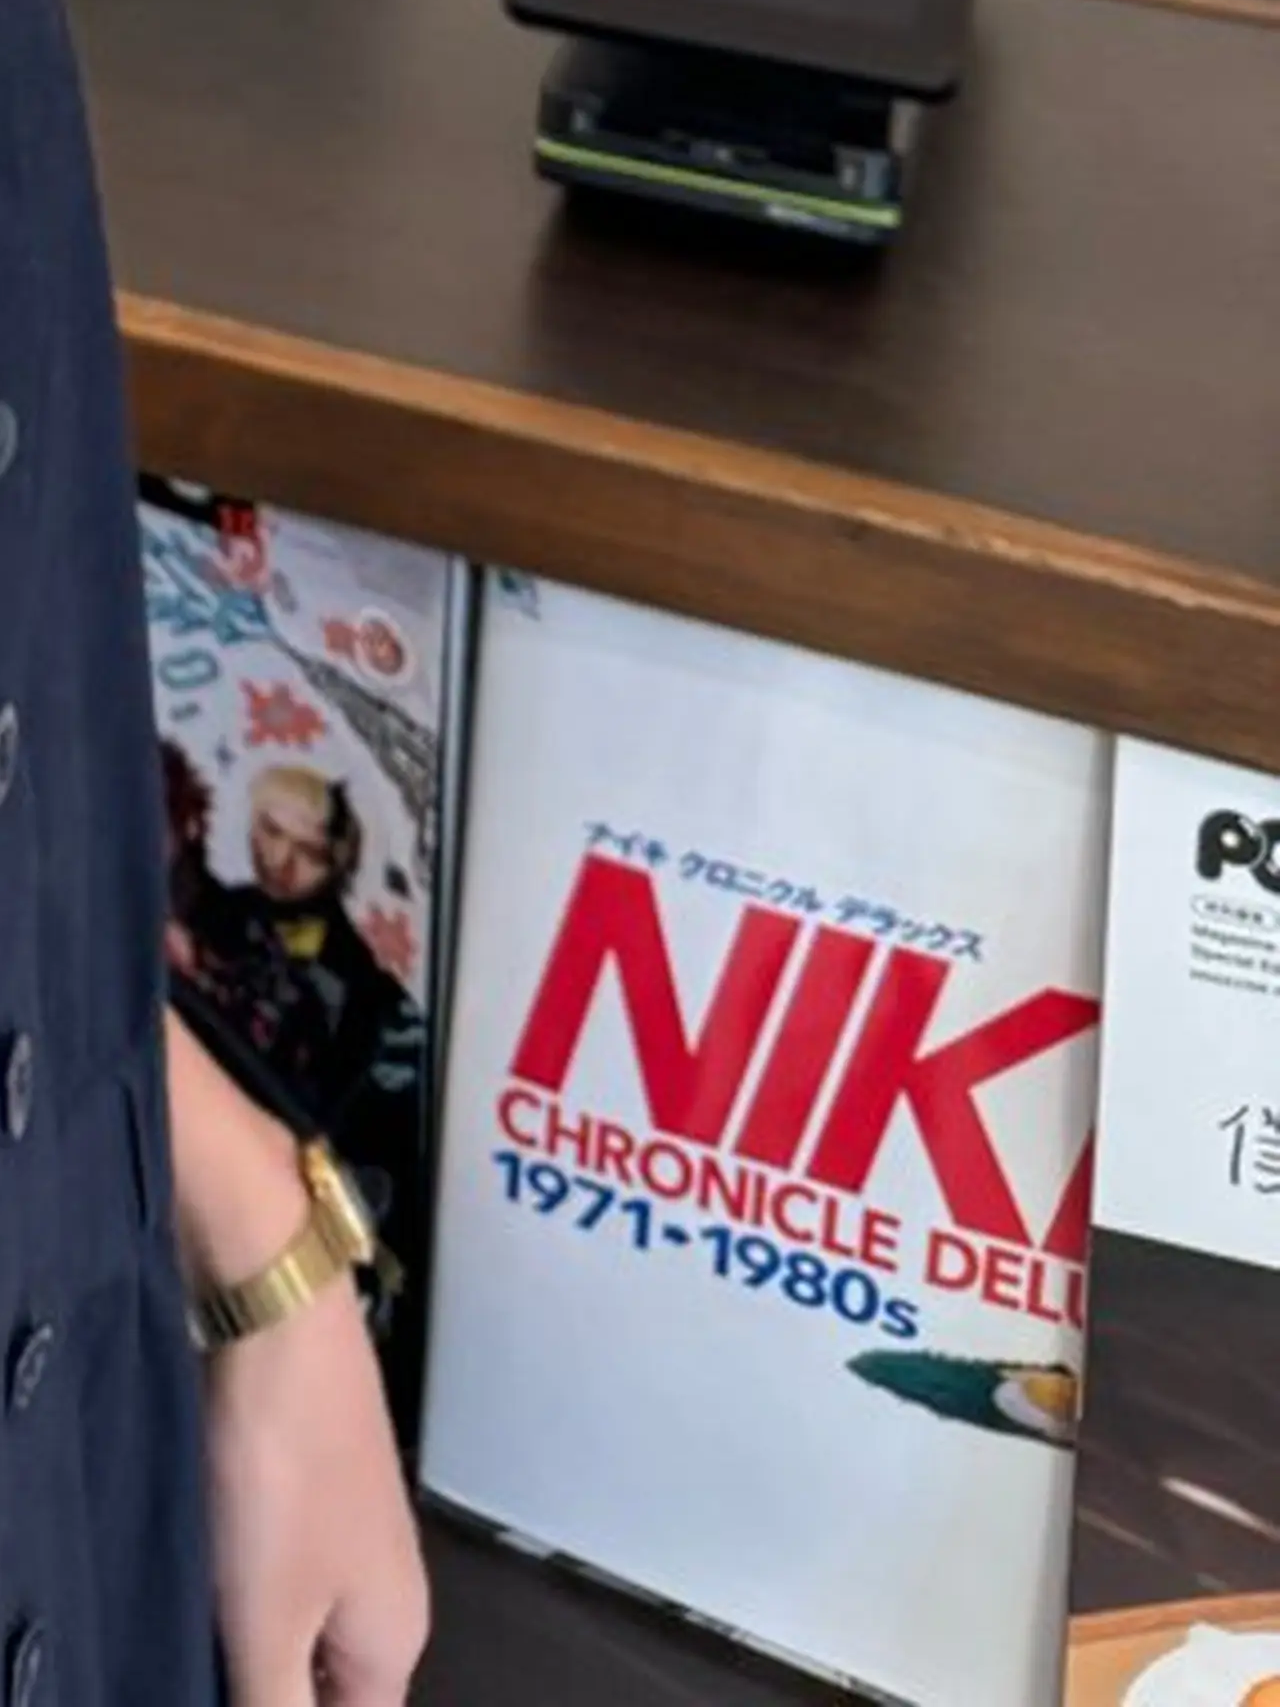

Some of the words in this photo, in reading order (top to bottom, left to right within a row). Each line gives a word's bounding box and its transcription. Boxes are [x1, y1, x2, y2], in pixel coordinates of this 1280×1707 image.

[583, 820, 669, 867] ナイキ
[679, 850, 823, 914] クロニクル
[835, 895, 986, 963] デラックス
[496, 1089, 903, 1273] CHRONICLE
